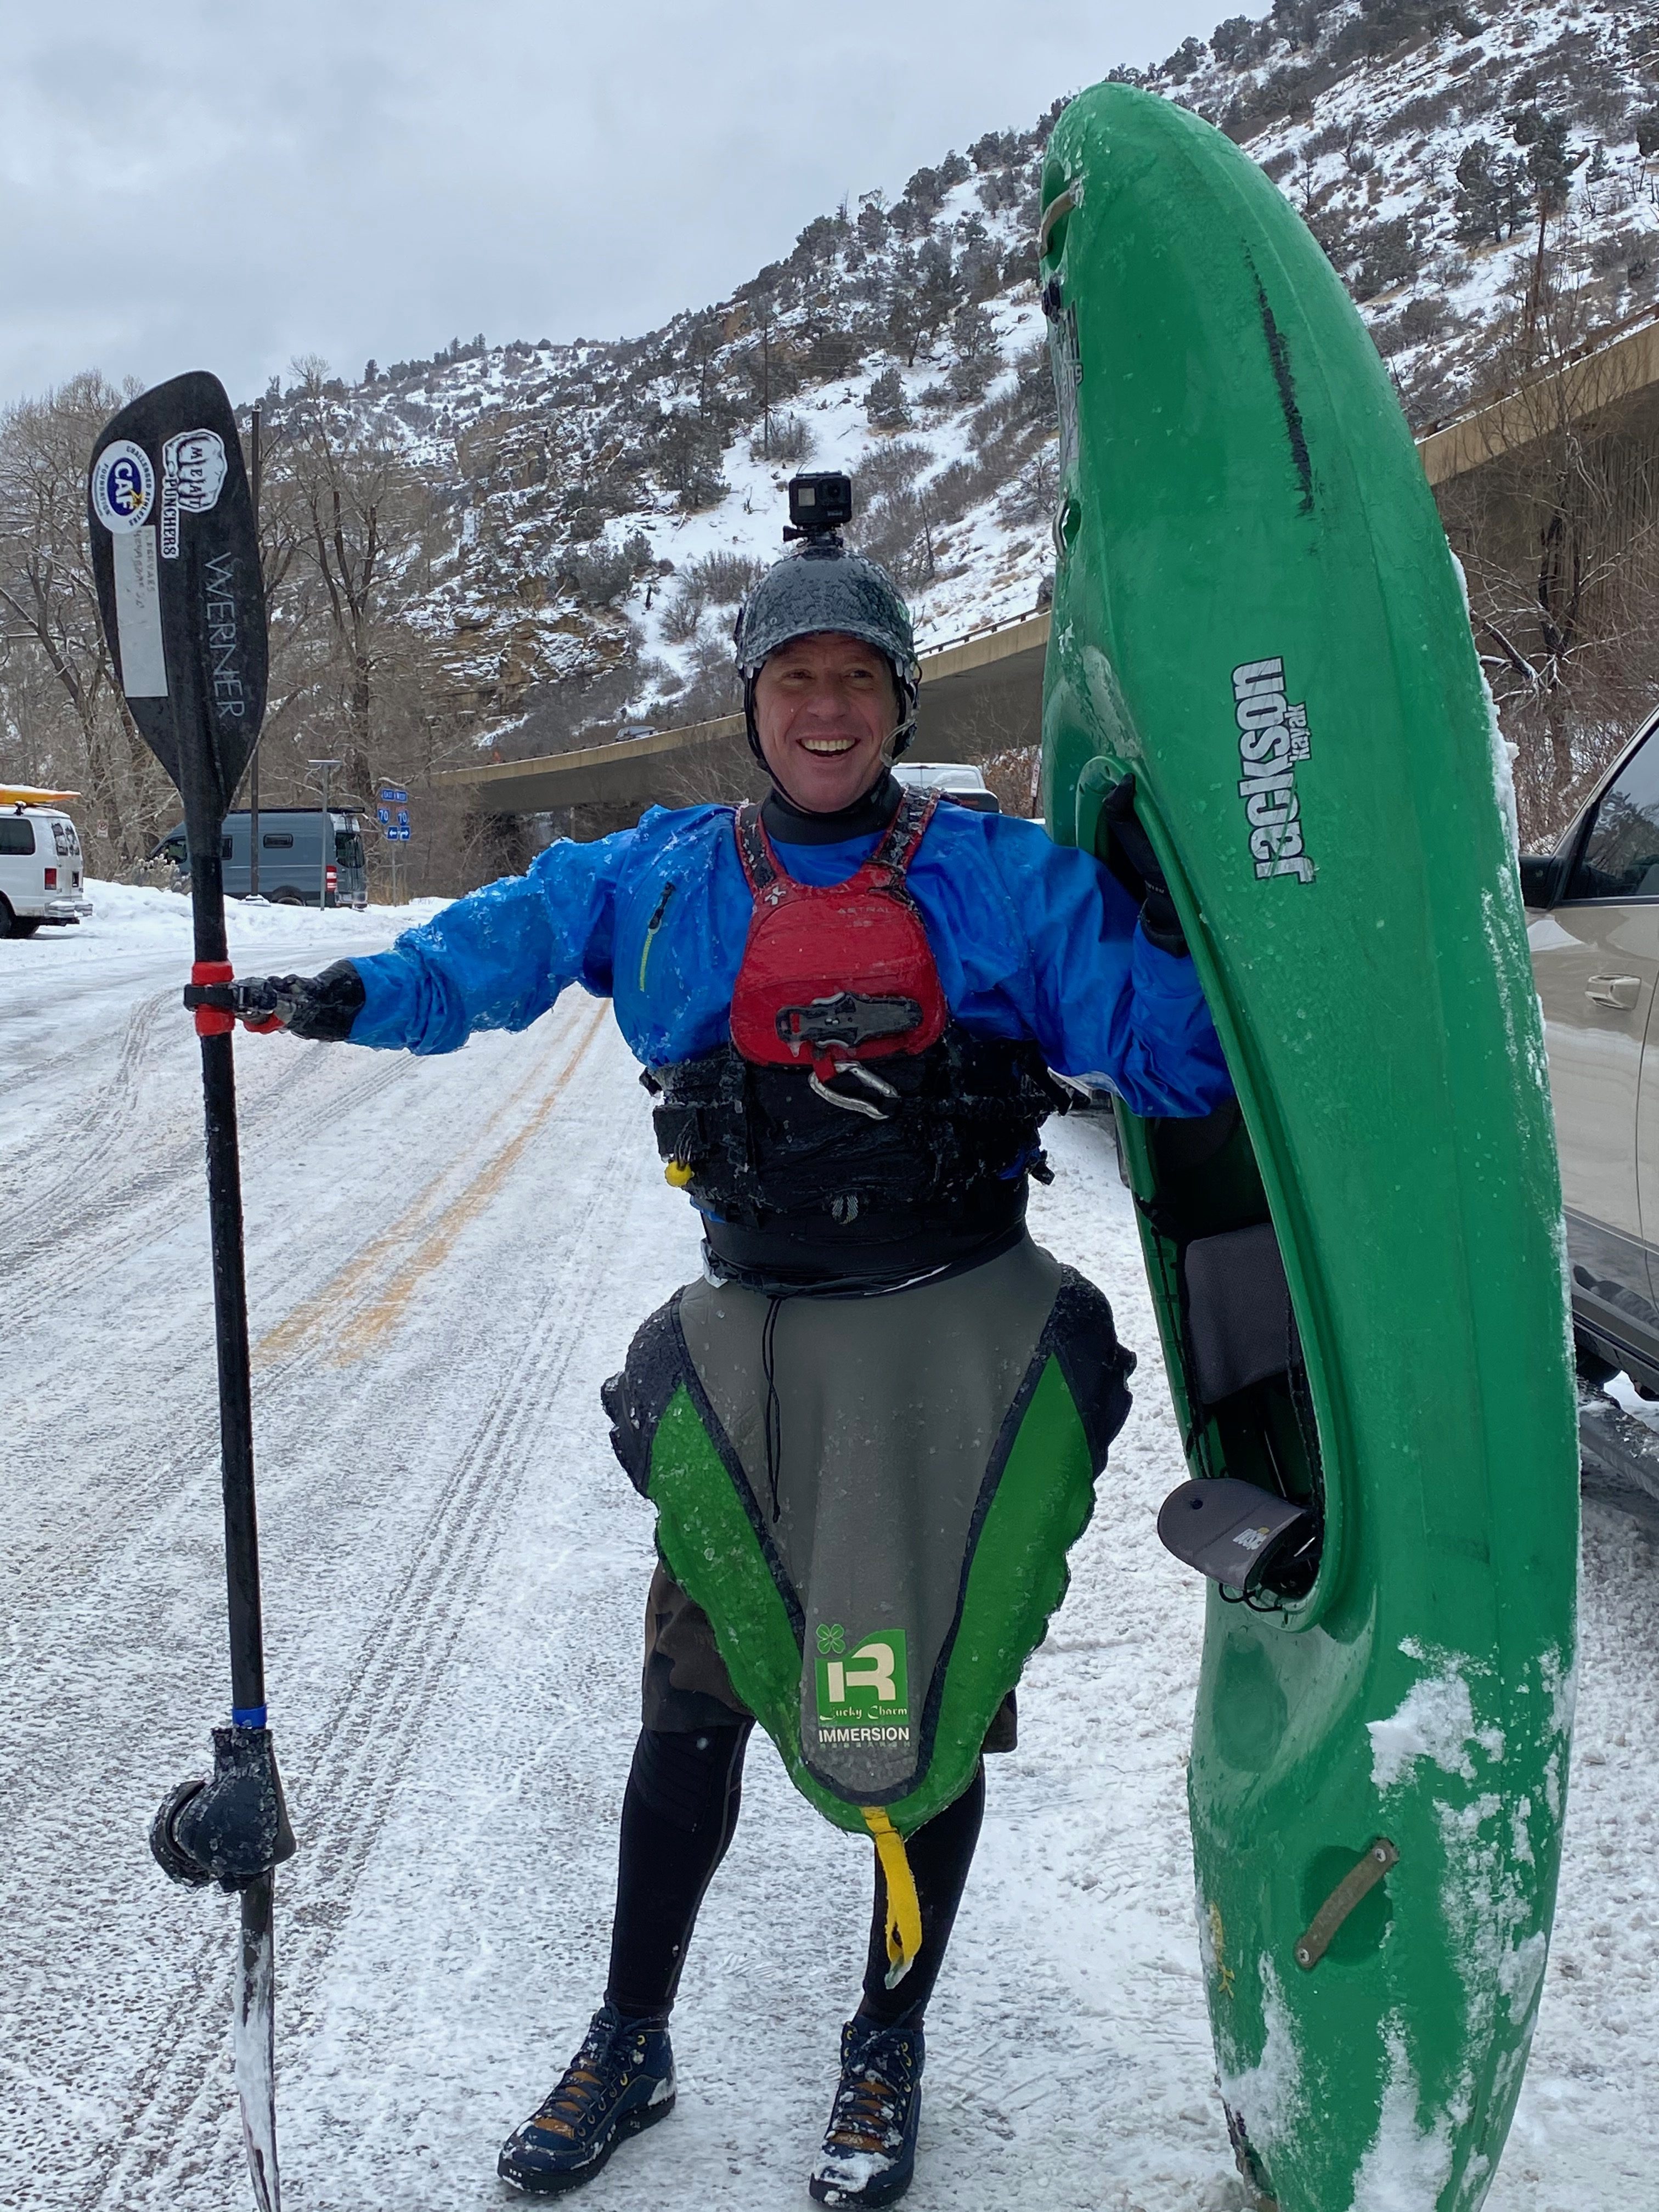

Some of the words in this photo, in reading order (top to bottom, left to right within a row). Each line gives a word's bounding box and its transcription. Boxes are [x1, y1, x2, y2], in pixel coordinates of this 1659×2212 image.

[114, 461, 134, 510] CAF
[190, 447, 202, 507] MEAT
[163, 478, 177, 555] PUNCHERS
[205, 552, 245, 718] WERNER
[379, 810, 388, 821] 70
[819, 1727, 910, 1743] IMMERSION
[868, 1705, 907, 1719] Charm
